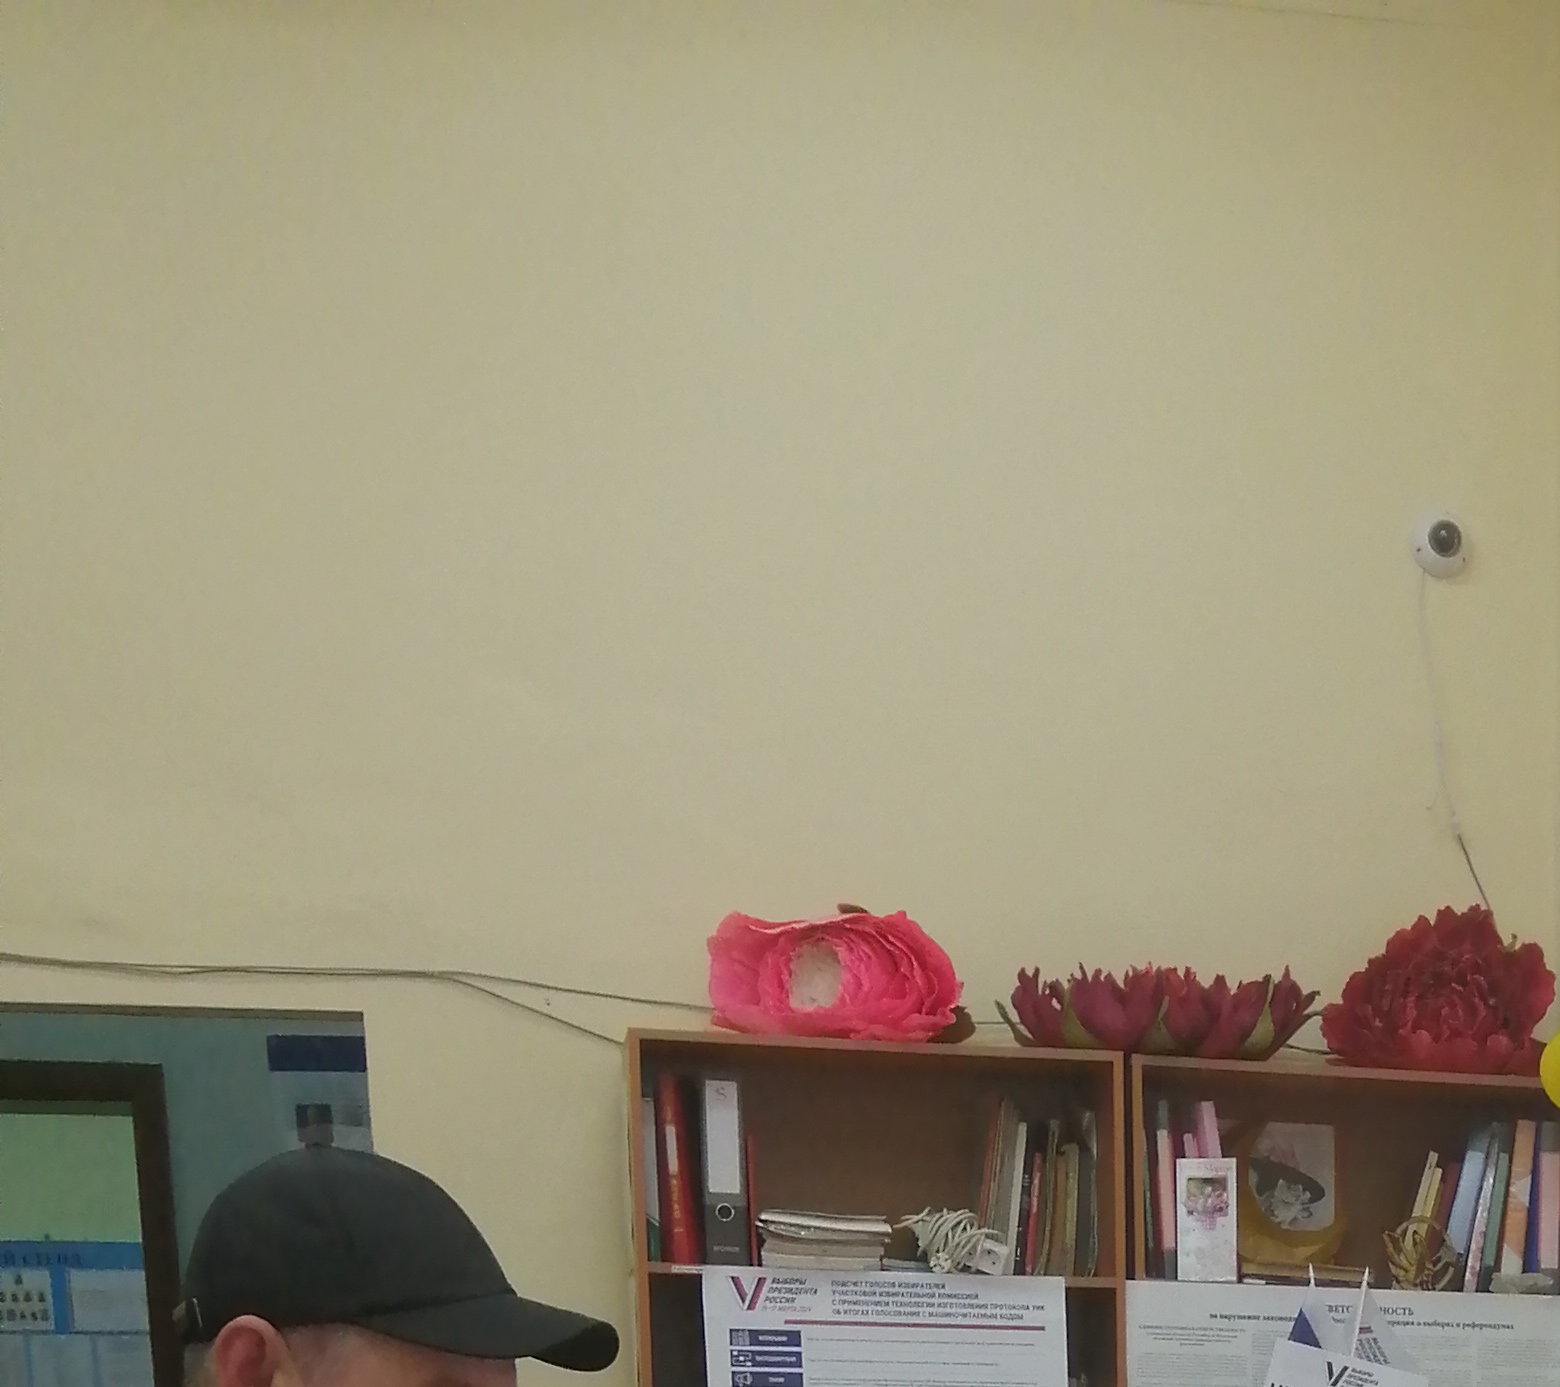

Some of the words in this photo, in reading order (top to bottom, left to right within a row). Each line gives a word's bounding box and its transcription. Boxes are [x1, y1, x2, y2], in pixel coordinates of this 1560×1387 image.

[771, 1277, 807, 1285] ВЫБОРЫ
[864, 1281, 896, 1289] ГОЛОСОВ
[898, 1281, 946, 1290] ИЗБИРАТЕЛЕЙ
[767, 1287, 818, 1296] ПРЕЗИДЕНТА
[831, 1289, 877, 1298] УЧАСТКОВОЙ
[878, 1290, 936, 1299] ИЗБИРАТЕЛЬНОЙ
[937, 1292, 979, 1300] КОМИССИЕЙ
[764, 1296, 797, 1304] РОССИИ
[838, 1299, 890, 1308] ПРИМЕНЕНИЕМ
[891, 1300, 936, 1309] ТЕХНОЛОГИИ
[937, 1302, 989, 1310] ИЗГОТОВЛЕНИЯ
[990, 1303, 1030, 1311] ПРОТОКОЛА
[832, 1308, 841, 1316] ОБ
[842, 1308, 869, 1316] ИТОГАХ
[871, 1309, 921, 1317] ГОЛОСОВАНИЯ
[928, 1311, 999, 1320] МАШИНОЧИТАЕМЫМ
